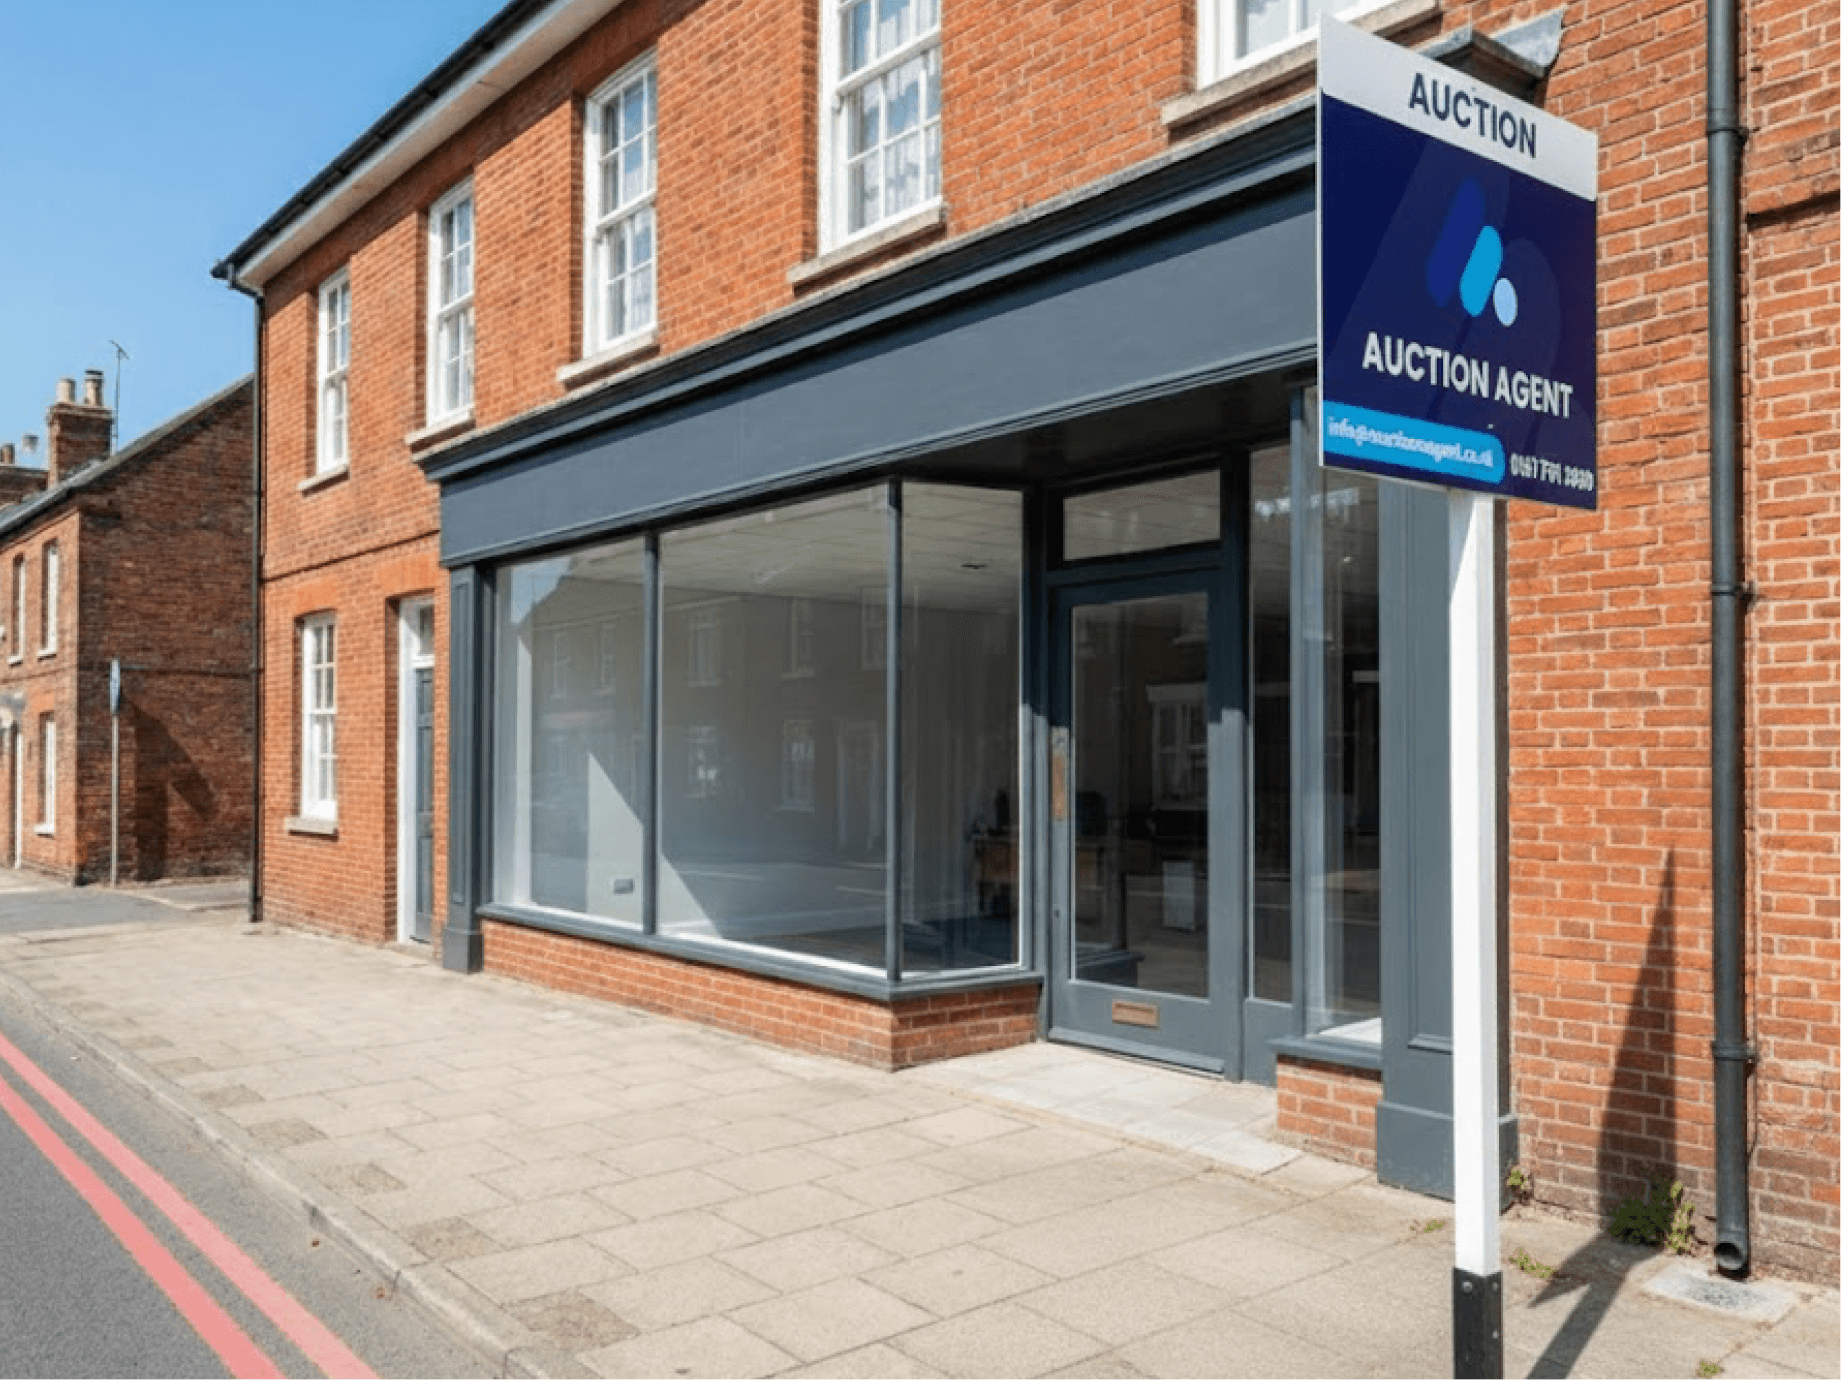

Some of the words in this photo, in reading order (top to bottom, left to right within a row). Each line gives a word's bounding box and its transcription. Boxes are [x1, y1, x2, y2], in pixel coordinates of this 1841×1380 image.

[1409, 72, 1537, 159] AUCTION
[1362, 331, 1489, 398] AUCTION
[1494, 366, 1574, 419] AGENT
